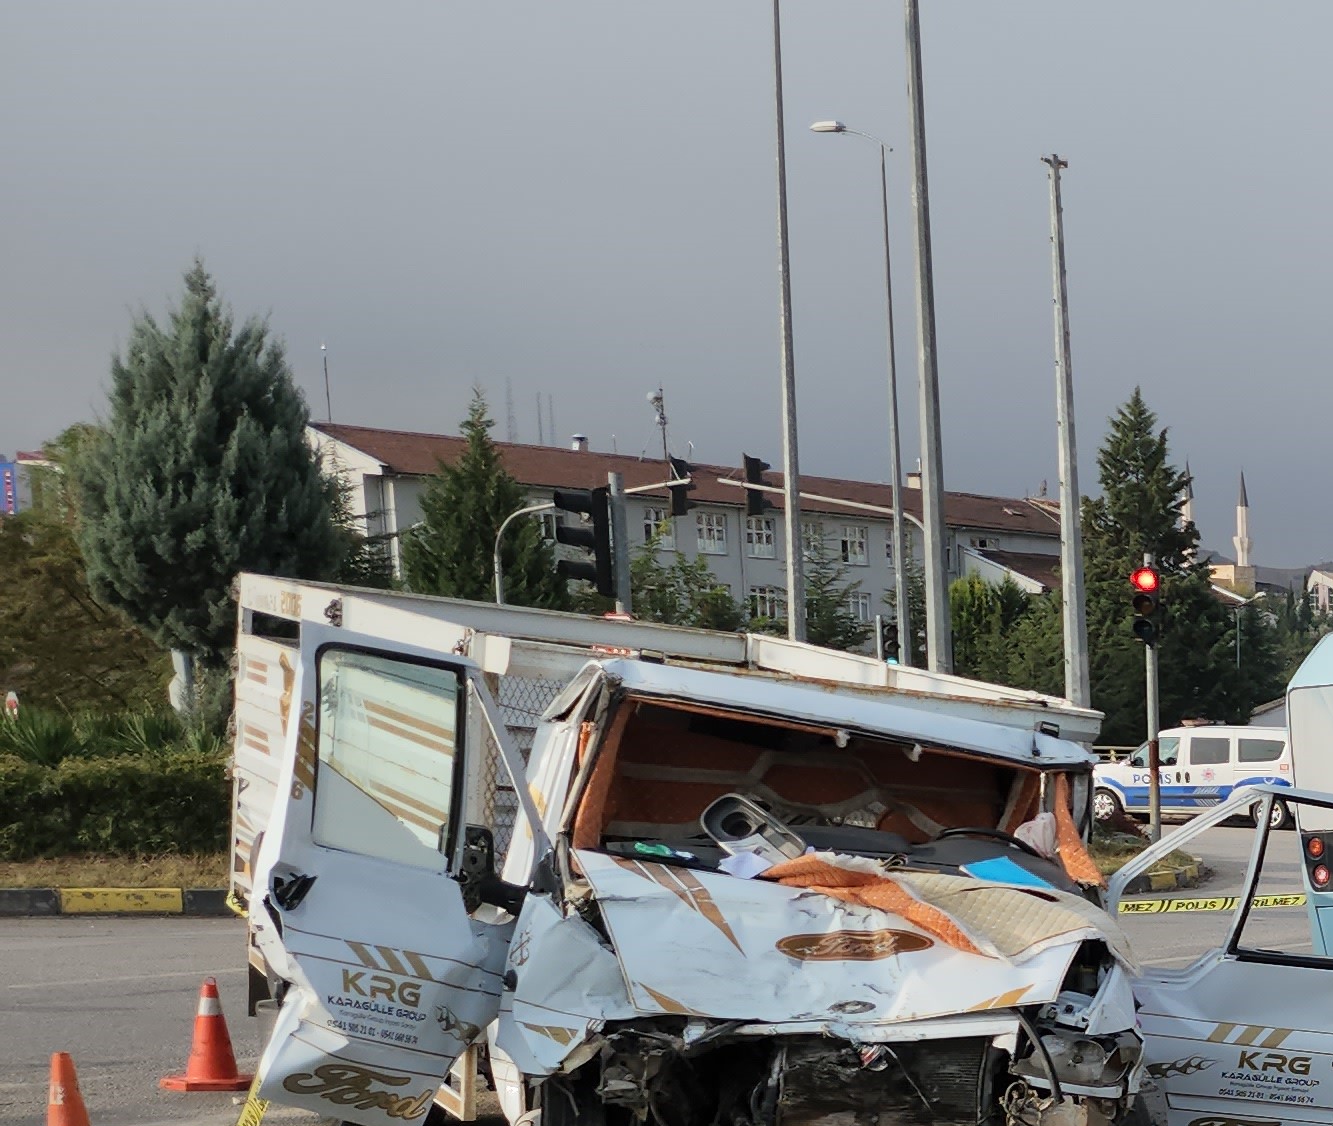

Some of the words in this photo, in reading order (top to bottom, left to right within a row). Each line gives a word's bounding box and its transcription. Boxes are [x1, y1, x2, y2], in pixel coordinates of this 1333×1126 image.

[342, 968, 423, 1009] KRG
[327, 995, 395, 1016] KARAGÜLLE
[396, 1008, 427, 1022] GROUP
[1238, 1050, 1313, 1076] KRG
[282, 1063, 434, 1121] Ford
[1221, 1071, 1283, 1084] KARAGÜLLE
[1284, 1077, 1320, 1088] GROUP
